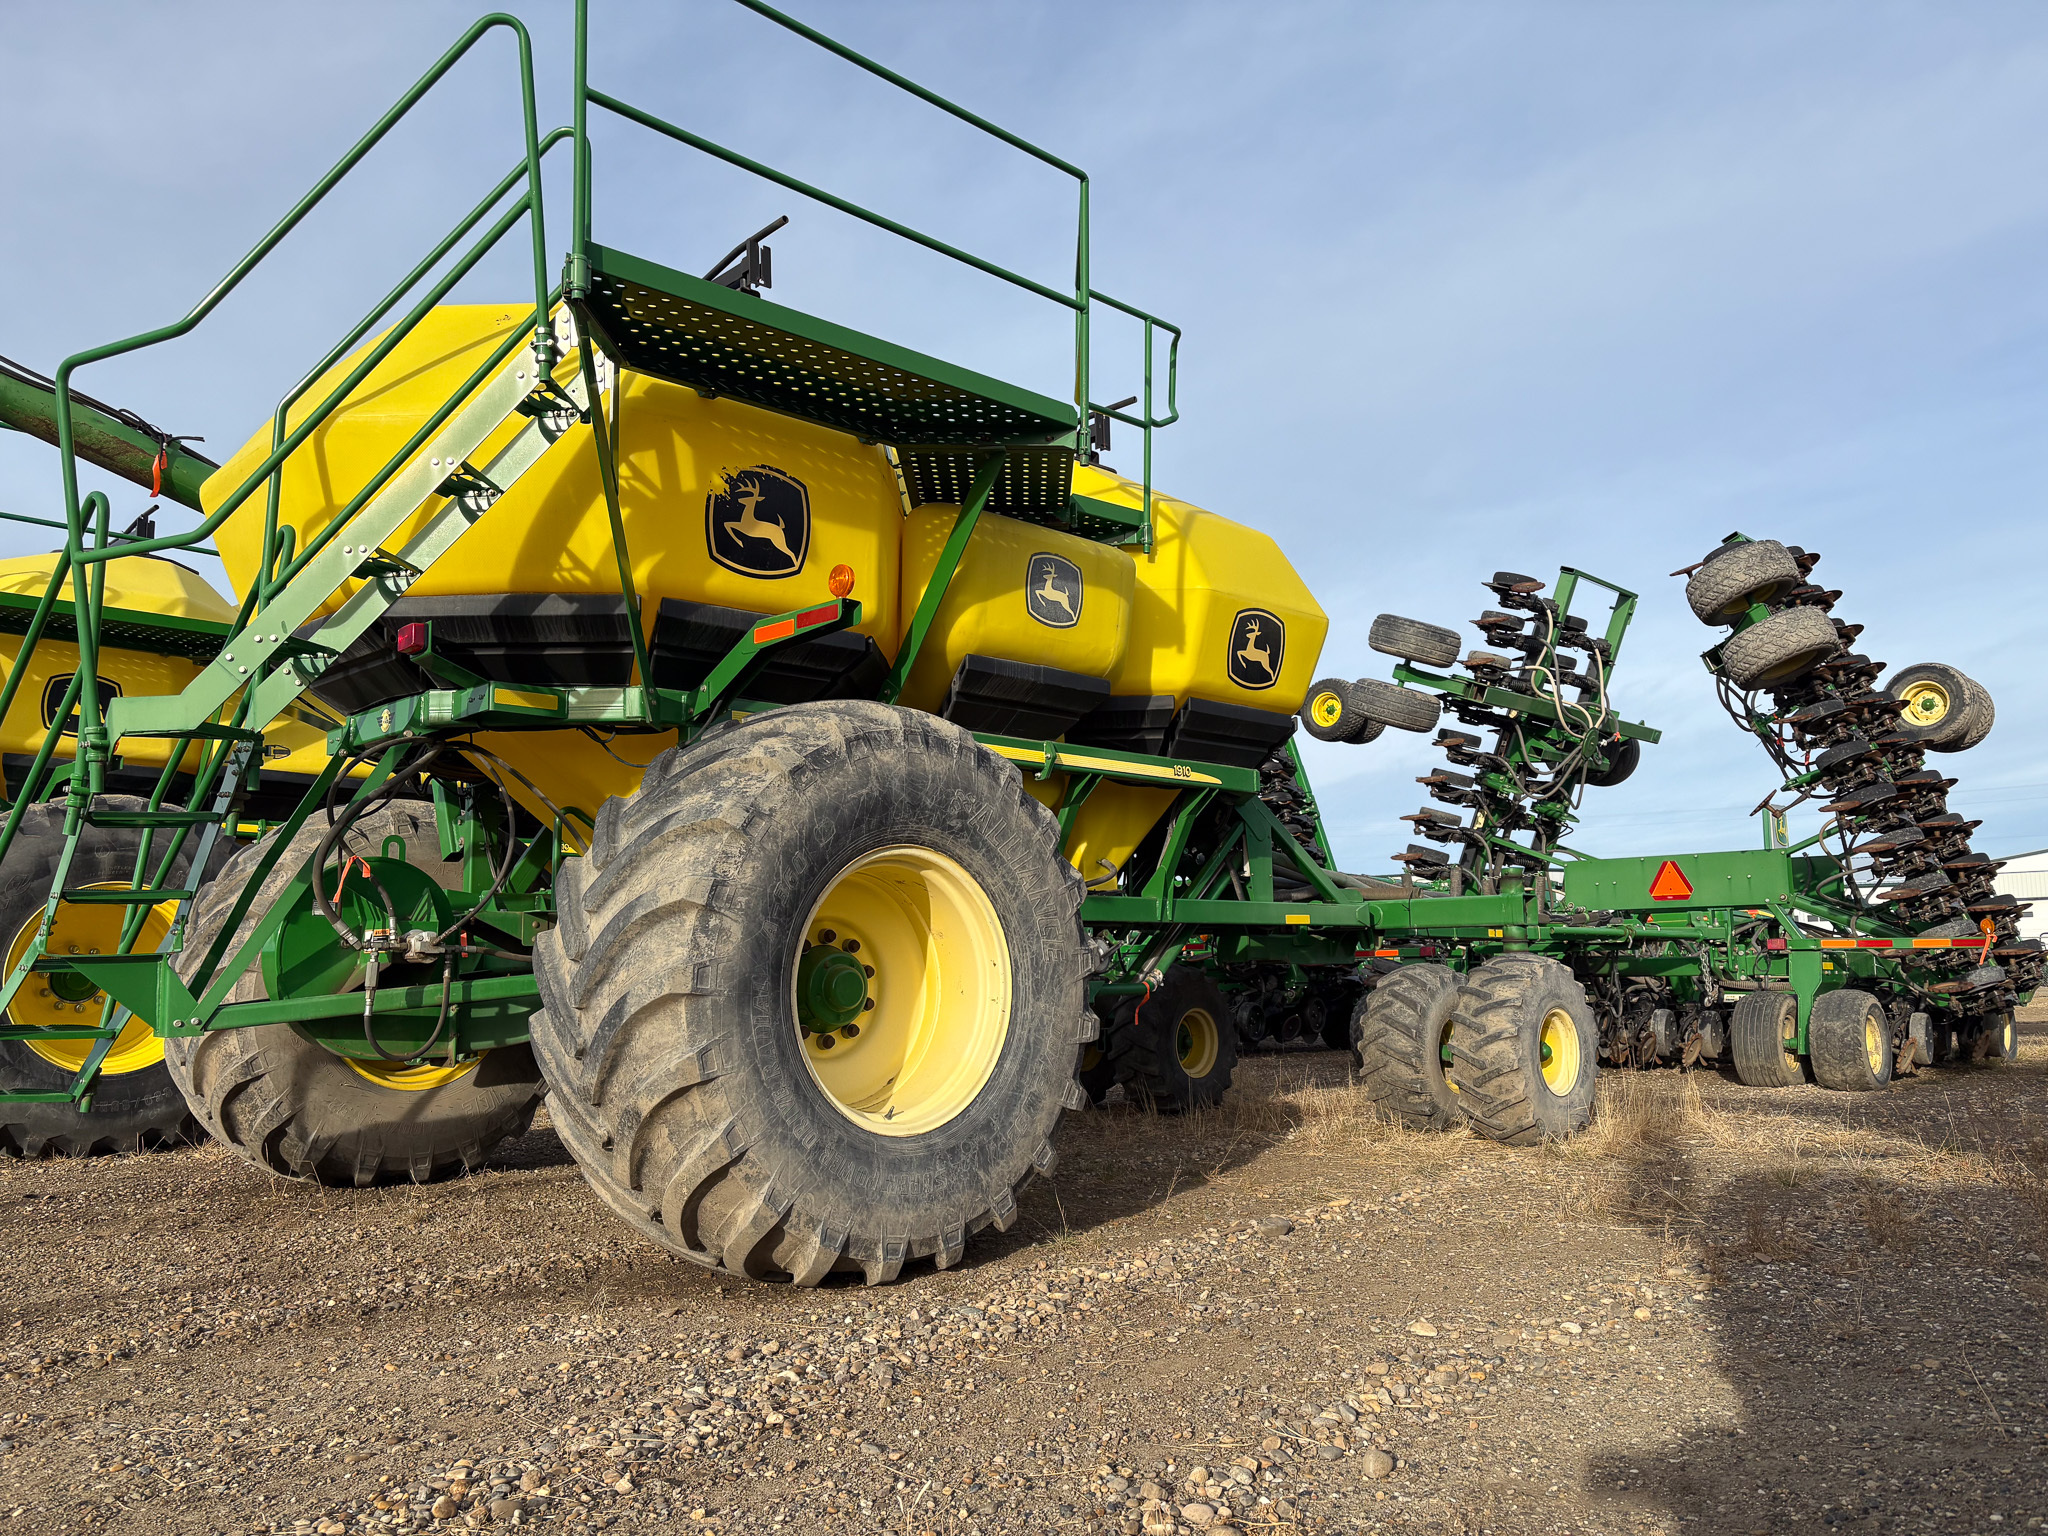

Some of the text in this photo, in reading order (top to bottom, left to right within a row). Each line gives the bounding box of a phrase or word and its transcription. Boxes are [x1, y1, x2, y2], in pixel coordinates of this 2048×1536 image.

[1173, 765, 1192, 777] 1910
[967, 803, 1066, 962] ALLIANCE
[751, 972, 782, 1081] RADIAL
[771, 1083, 819, 1150] DRIVE
[818, 1145, 881, 1191] POWER
